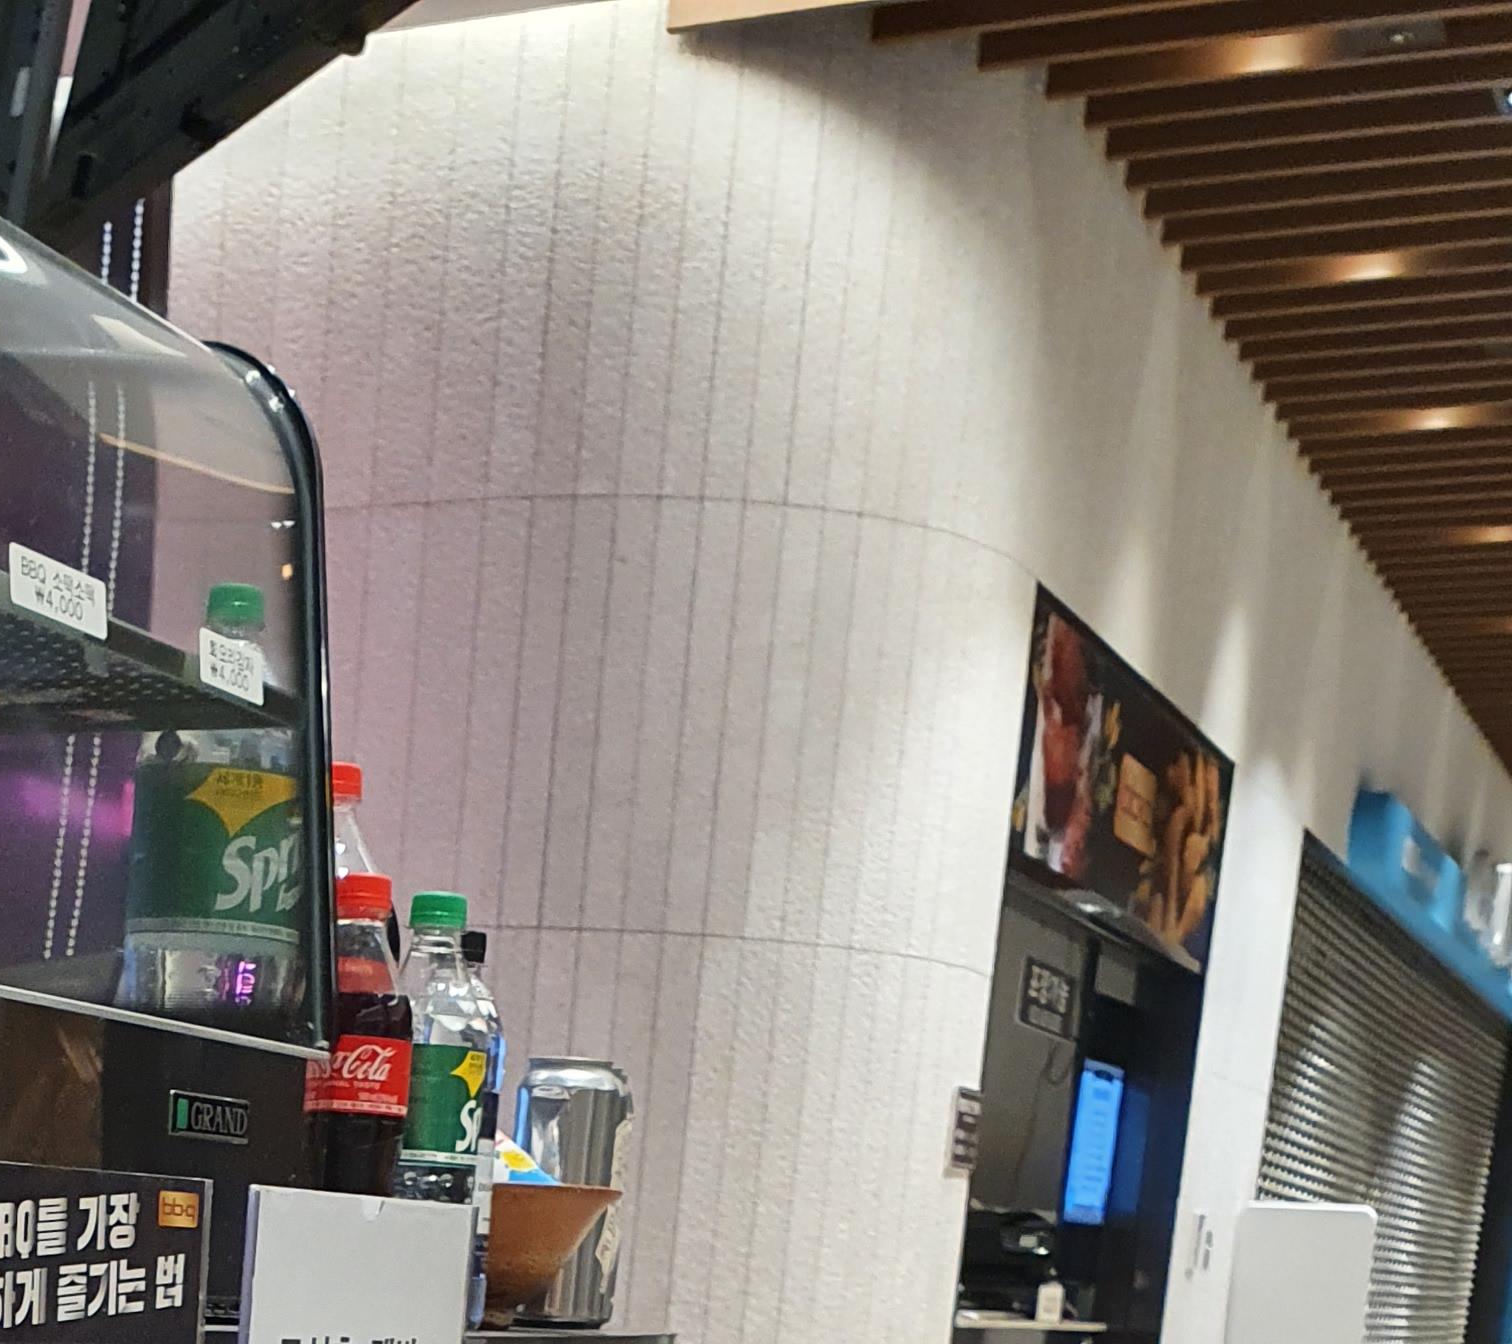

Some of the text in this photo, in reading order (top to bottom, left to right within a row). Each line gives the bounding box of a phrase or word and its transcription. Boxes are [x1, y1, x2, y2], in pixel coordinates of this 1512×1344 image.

[21, 555, 46, 585] BBQ
[191, 1101, 248, 1136] GRAND
[76, 1192, 140, 1251] 가장
[56, 1258, 146, 1322] 즐기는
[155, 1252, 186, 1309] 법
